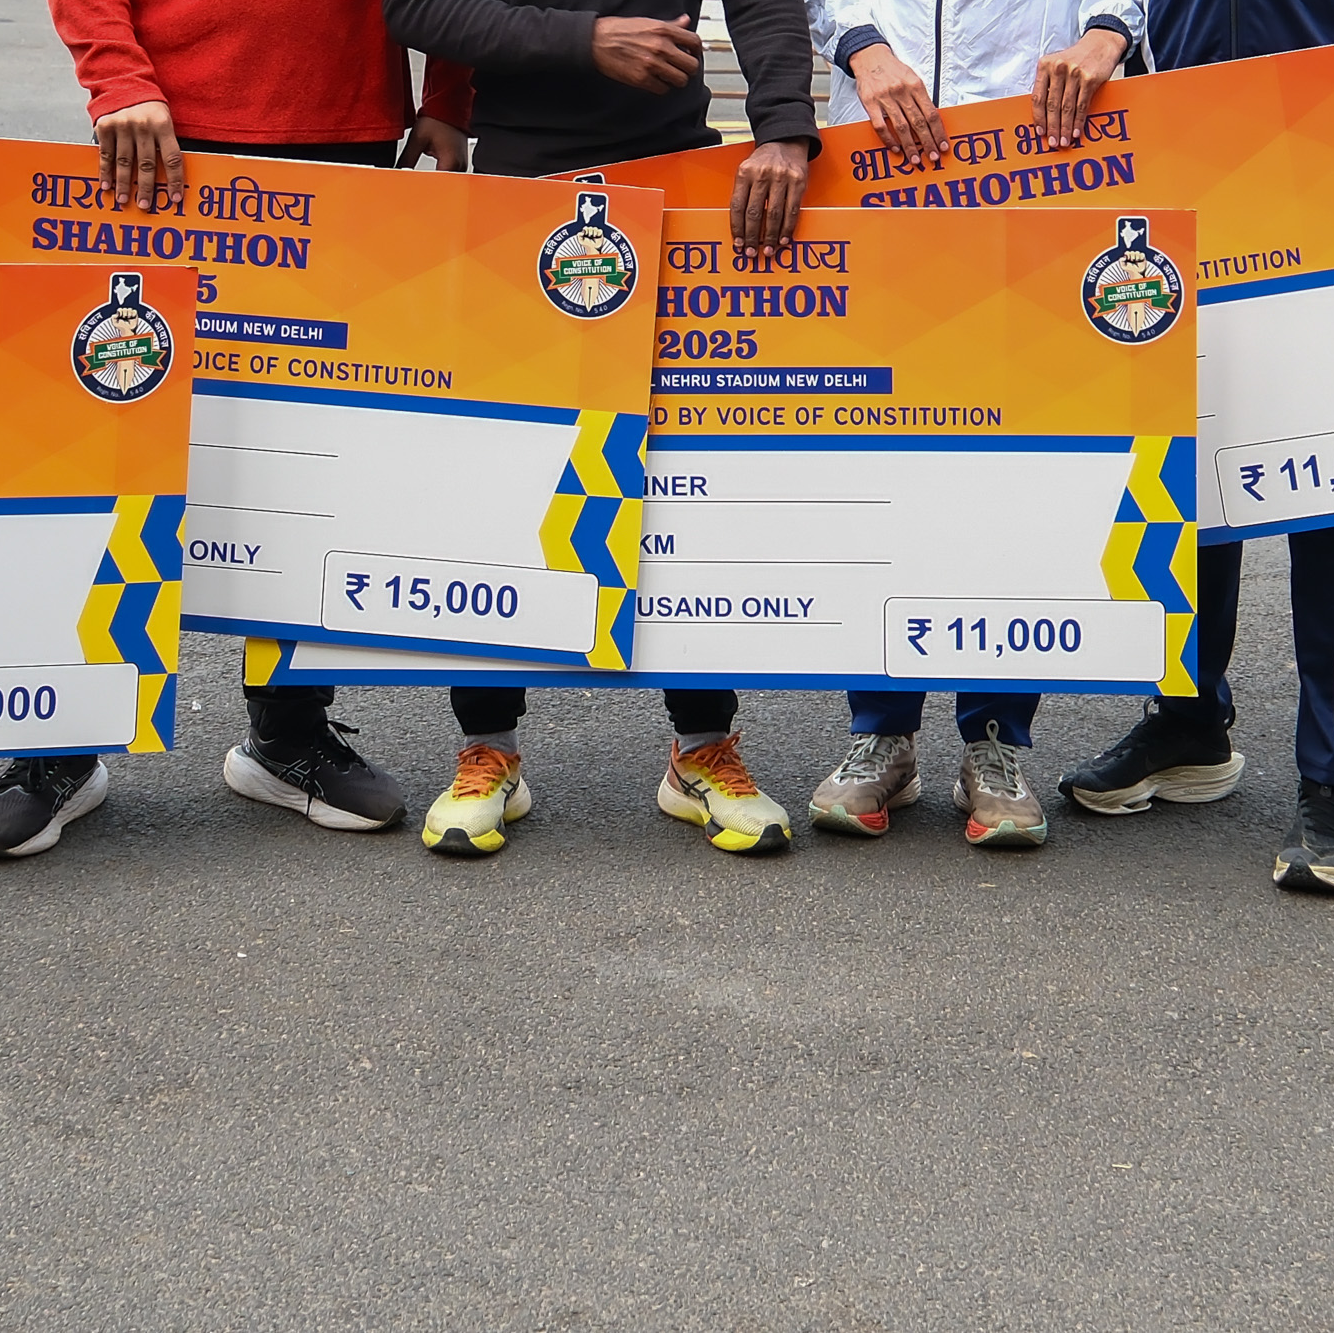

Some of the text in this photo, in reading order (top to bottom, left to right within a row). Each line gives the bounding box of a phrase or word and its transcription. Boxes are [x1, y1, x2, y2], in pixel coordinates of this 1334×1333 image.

[950, 129, 1006, 165] का
[198, 177, 315, 226] भविष्य
[33, 218, 310, 268] SHAHOTHON
[666, 242, 721, 273] का
[1108, 289, 1157, 301] CONSTITUTION
[1115, 284, 1137, 293] VOICE
[244, 322, 322, 340] NEW DELHI
[658, 330, 757, 359] 2025
[250, 356, 451, 389] OF CONSTITUTION
[662, 374, 866, 387] NEHRU STADIUM NEW DELHI
[679, 407, 1000, 426] BY VOICE OF CONSTITUTION
[190, 540, 261, 564] ONLY
[386, 576, 517, 618] 15,000
[742, 598, 814, 617] ONLY
[948, 618, 1081, 657] 11,000
